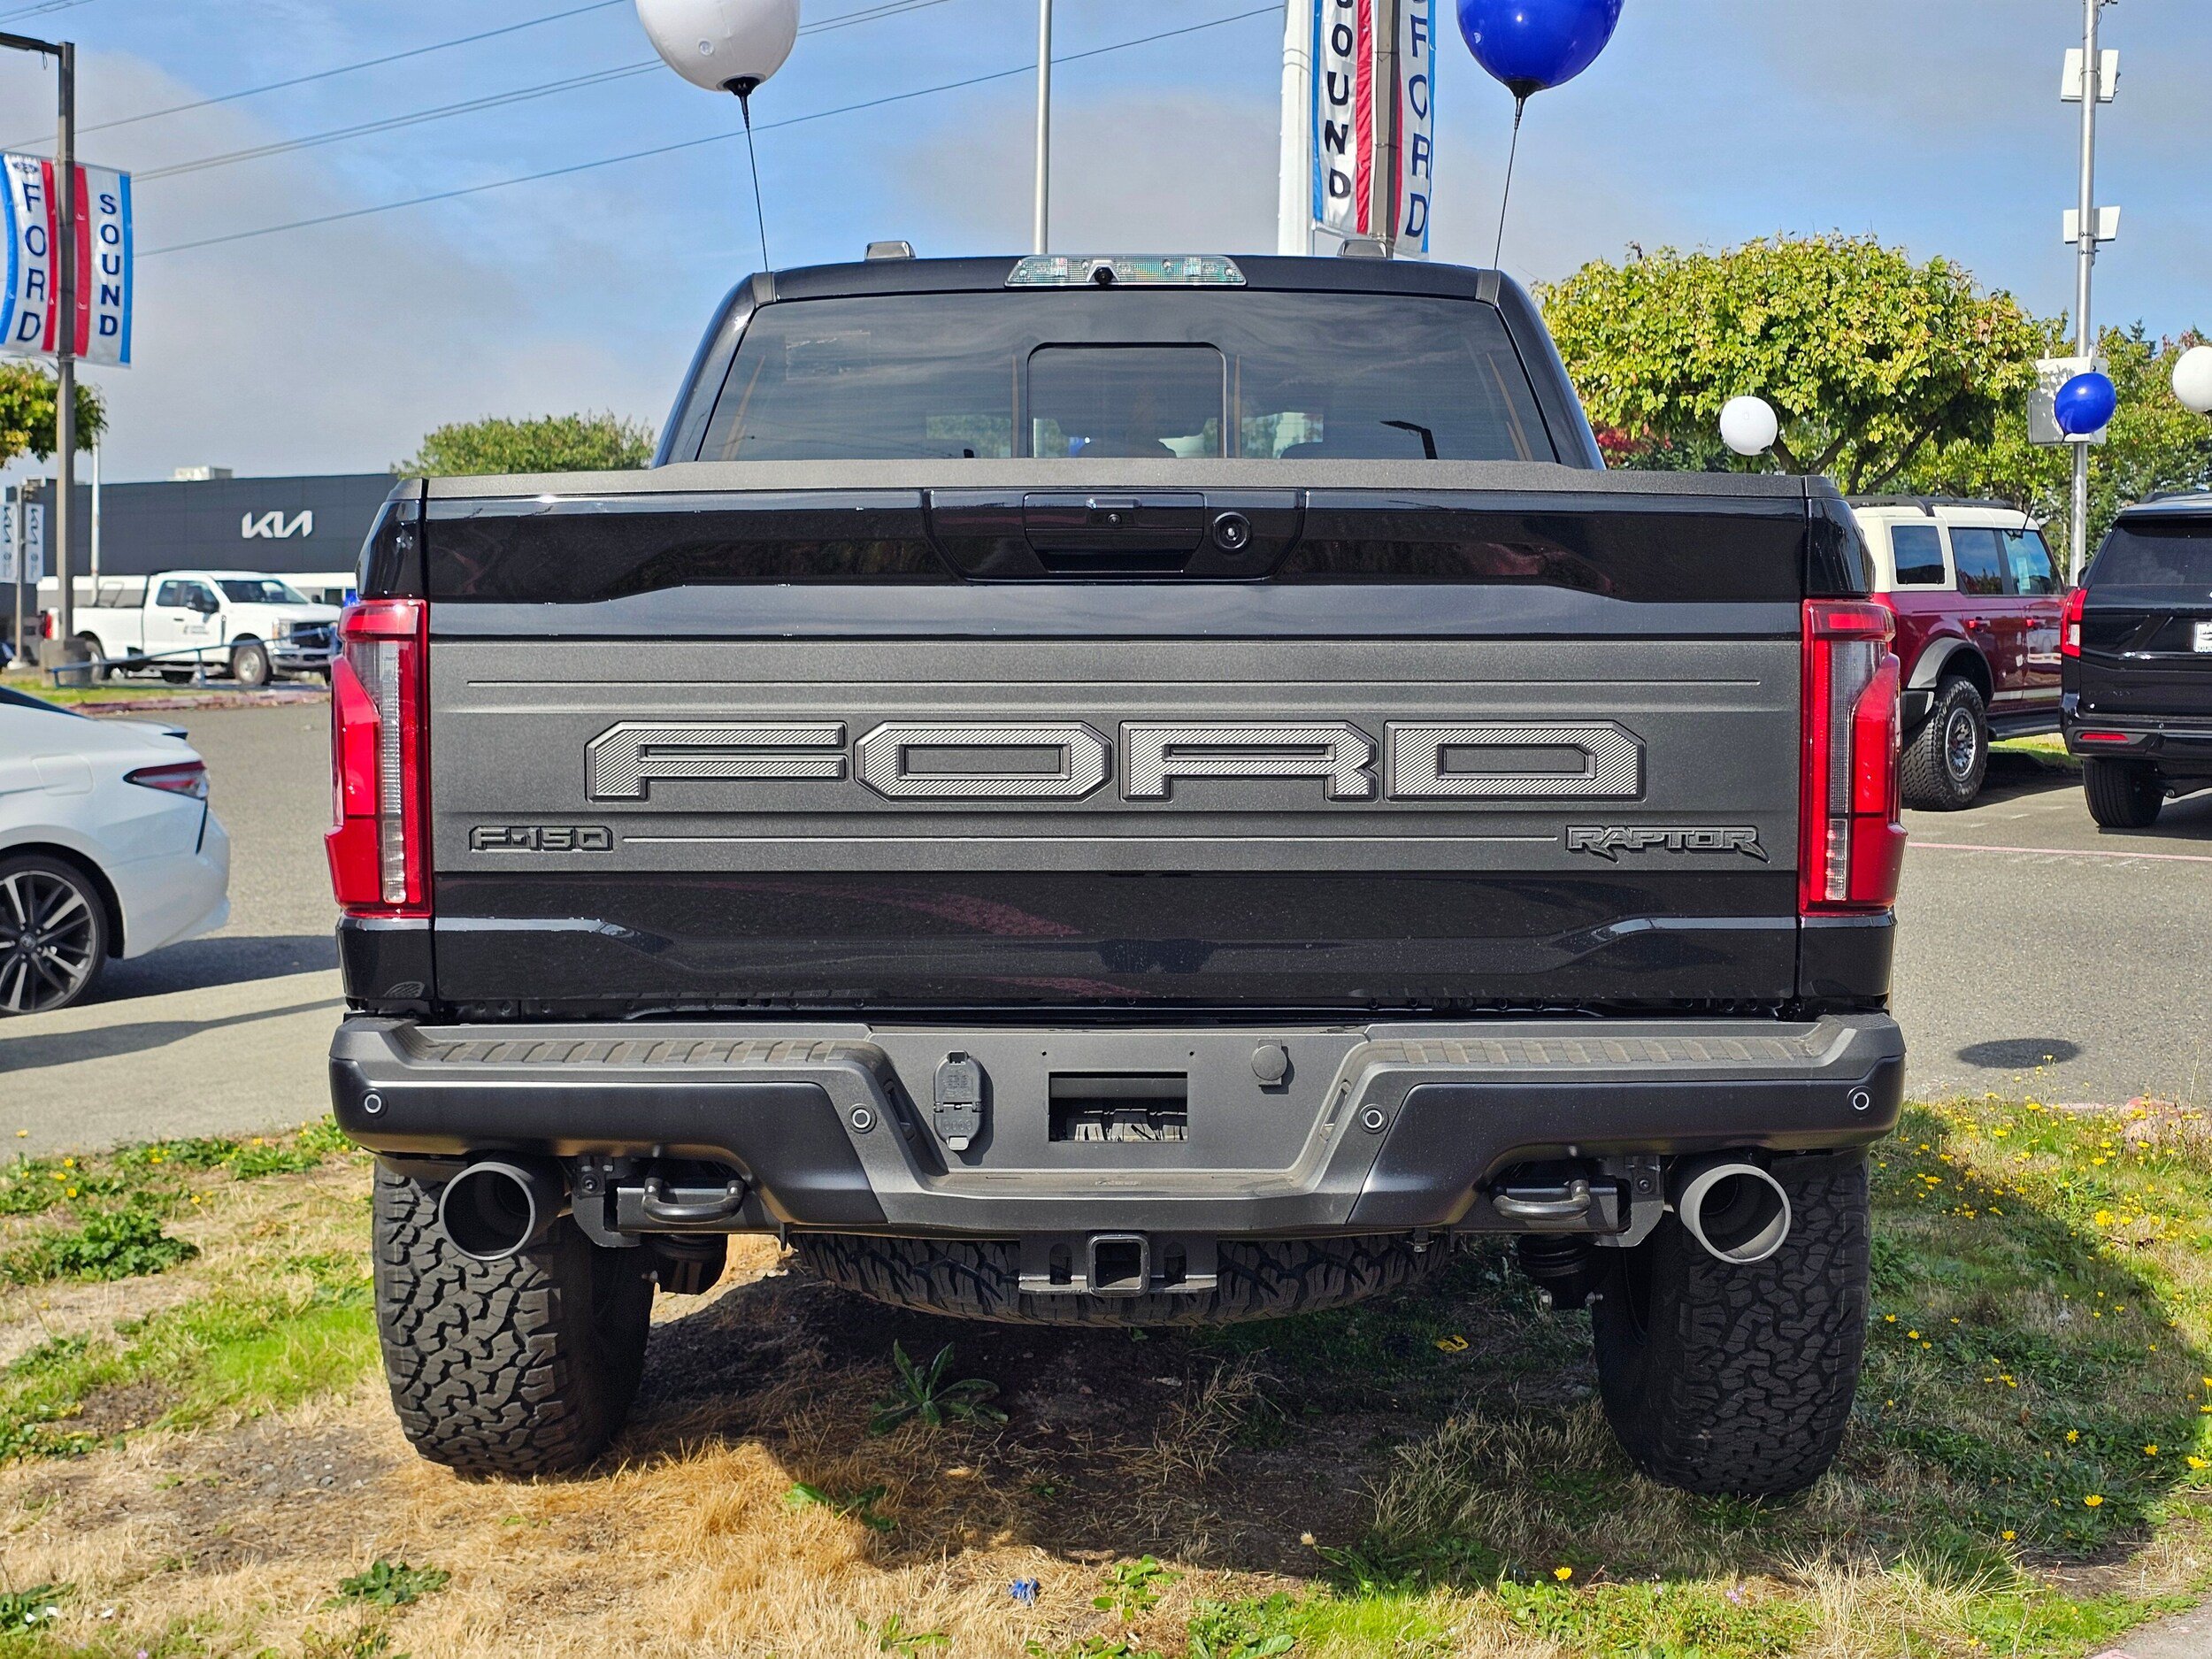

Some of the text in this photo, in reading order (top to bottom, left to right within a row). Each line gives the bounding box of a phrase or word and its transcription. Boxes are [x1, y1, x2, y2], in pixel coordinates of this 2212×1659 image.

[1325, 0, 1354, 199] OUND
[1405, 14, 1431, 237] FORD
[16, 182, 47, 342] FORD
[99, 193, 120, 336] SOUND
[242, 510, 313, 539] KIA
[585, 721, 1646, 803] FORD
[469, 826, 613, 852] F-150
[1565, 825, 1770, 864] RAPTOR
